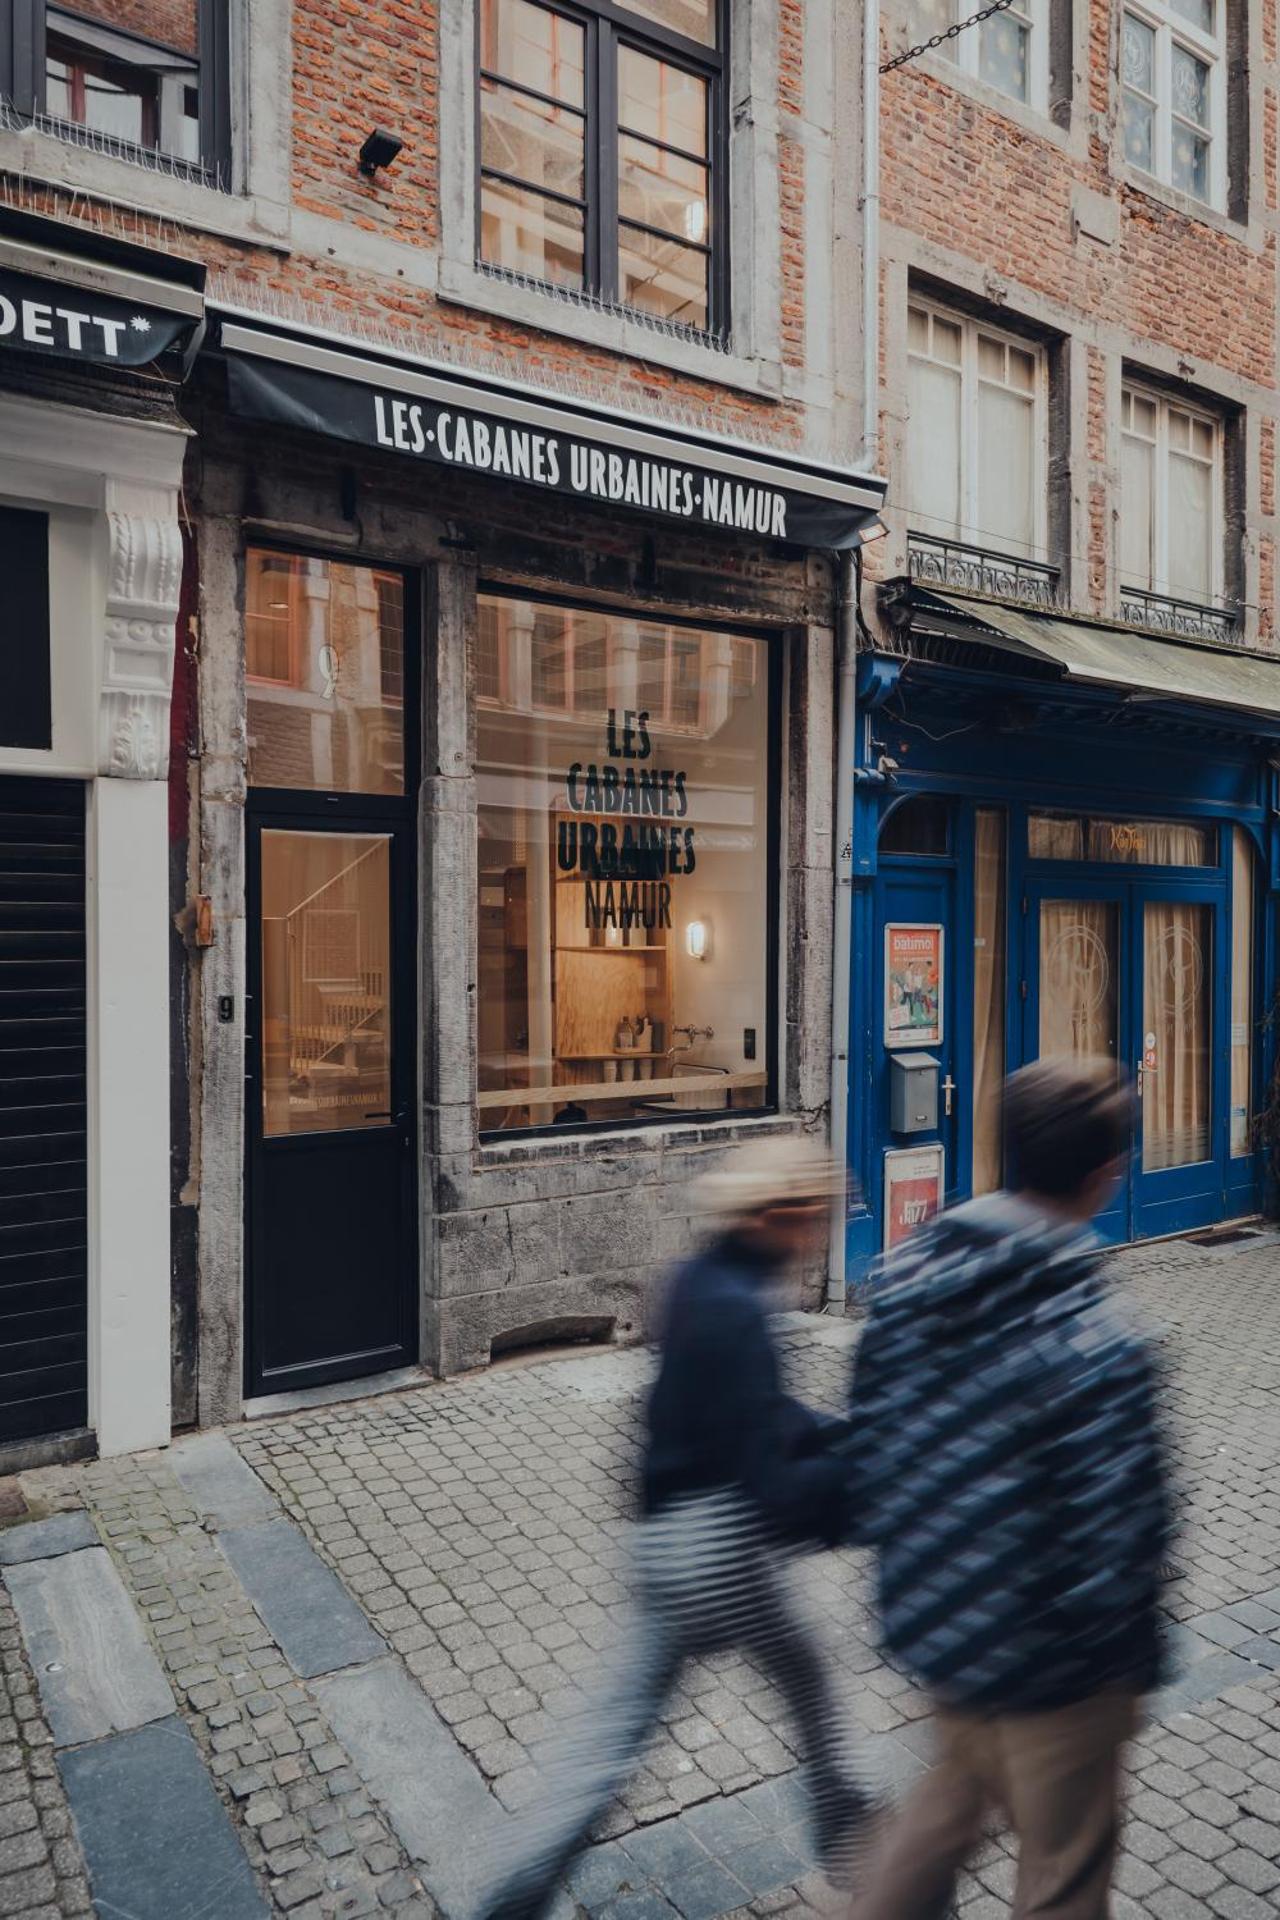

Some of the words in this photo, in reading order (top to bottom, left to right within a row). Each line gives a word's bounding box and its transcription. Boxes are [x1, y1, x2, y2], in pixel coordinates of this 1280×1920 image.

[608, 708, 651, 759] LES
[567, 762, 688, 817] CABANES
[558, 821, 696, 875] URBAINES
[584, 880, 672, 929] NAMUR
[221, 996, 233, 1020] 9
